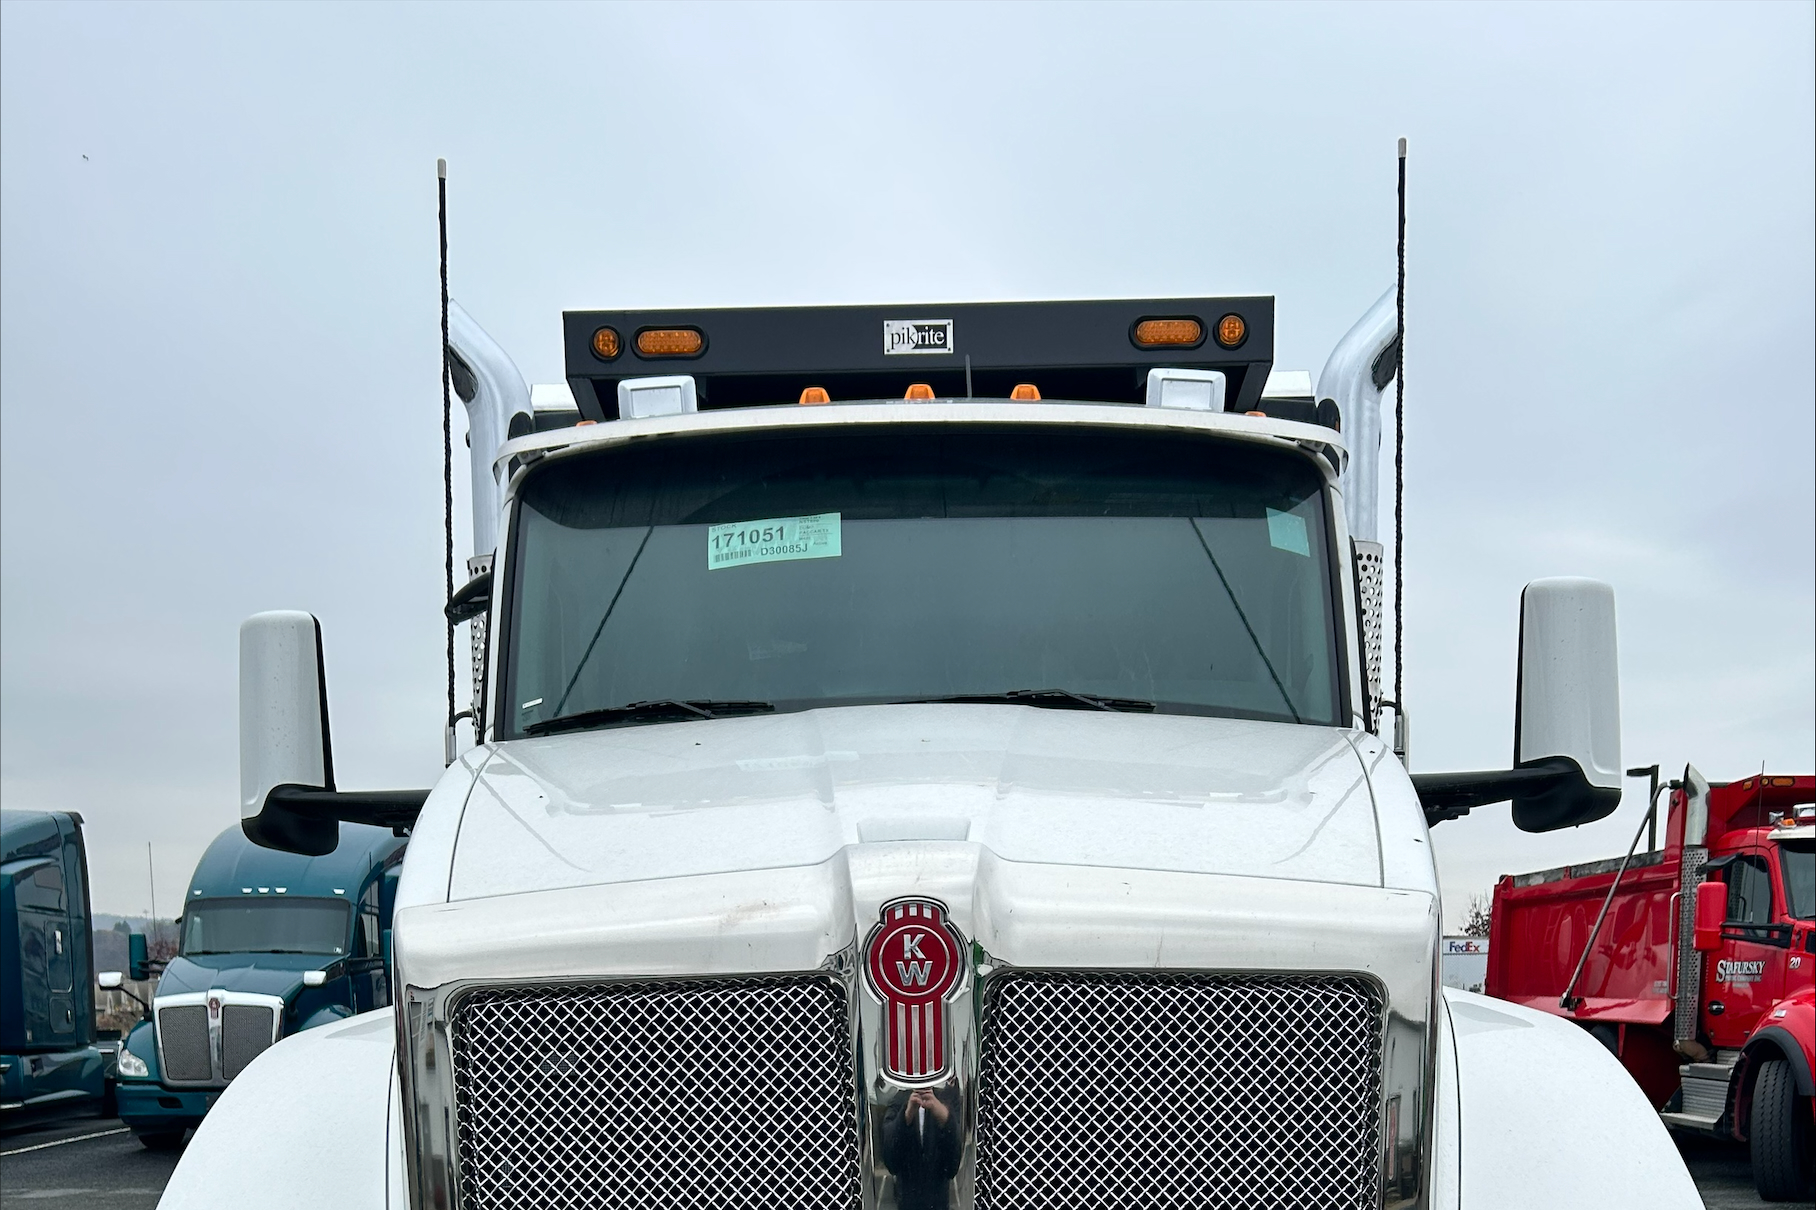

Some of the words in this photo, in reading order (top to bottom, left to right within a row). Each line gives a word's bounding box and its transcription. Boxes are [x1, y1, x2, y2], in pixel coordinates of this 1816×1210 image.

[711, 523, 738, 533] STOCK
[711, 525, 785, 550] 171051
[760, 543, 808, 557] D30085J
[1449, 941, 1480, 953] FedEx
[1789, 956, 1802, 970] 20
[1715, 959, 1766, 983] STAFURSKY
